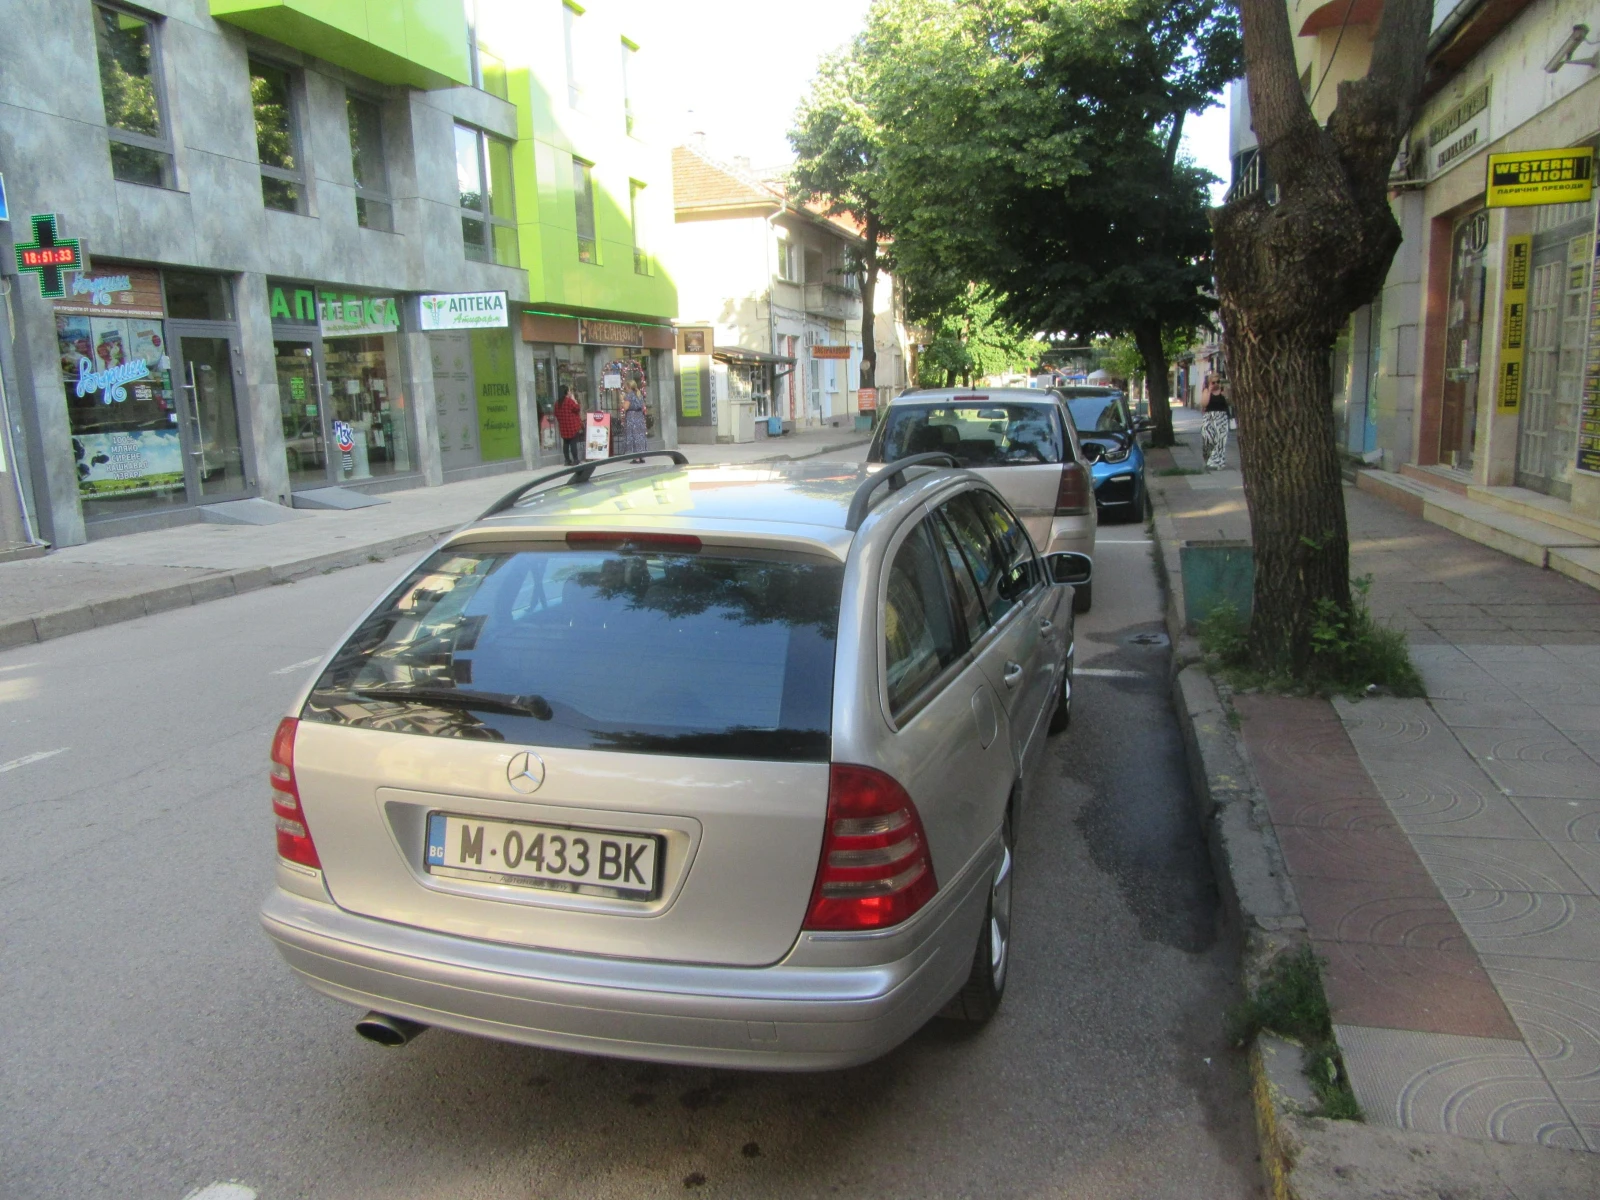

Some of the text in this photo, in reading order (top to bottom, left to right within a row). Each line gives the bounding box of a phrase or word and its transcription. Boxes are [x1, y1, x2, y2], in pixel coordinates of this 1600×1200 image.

[1496, 159, 1573, 174] WESTERN
[1519, 169, 1572, 183] UNION
[1497, 183, 1583, 194] ПАРИЧНИ ПРЕВОДИ
[24, 249, 72, 264] 18:51:33
[271, 287, 400, 326] АПТЕКА
[449, 295, 503, 312] АПТЕКА
[483, 384, 511, 397] АПТЕКА
[113, 436, 136, 444] 100%
[111, 445, 138, 453] МЛЯКО
[112, 453, 141, 462] СИРЕНЕ
[106, 462, 149, 472] КАШКАВАЛ
[114, 472, 143, 480] ИЗВАРА
[429, 845, 444, 858] BG
